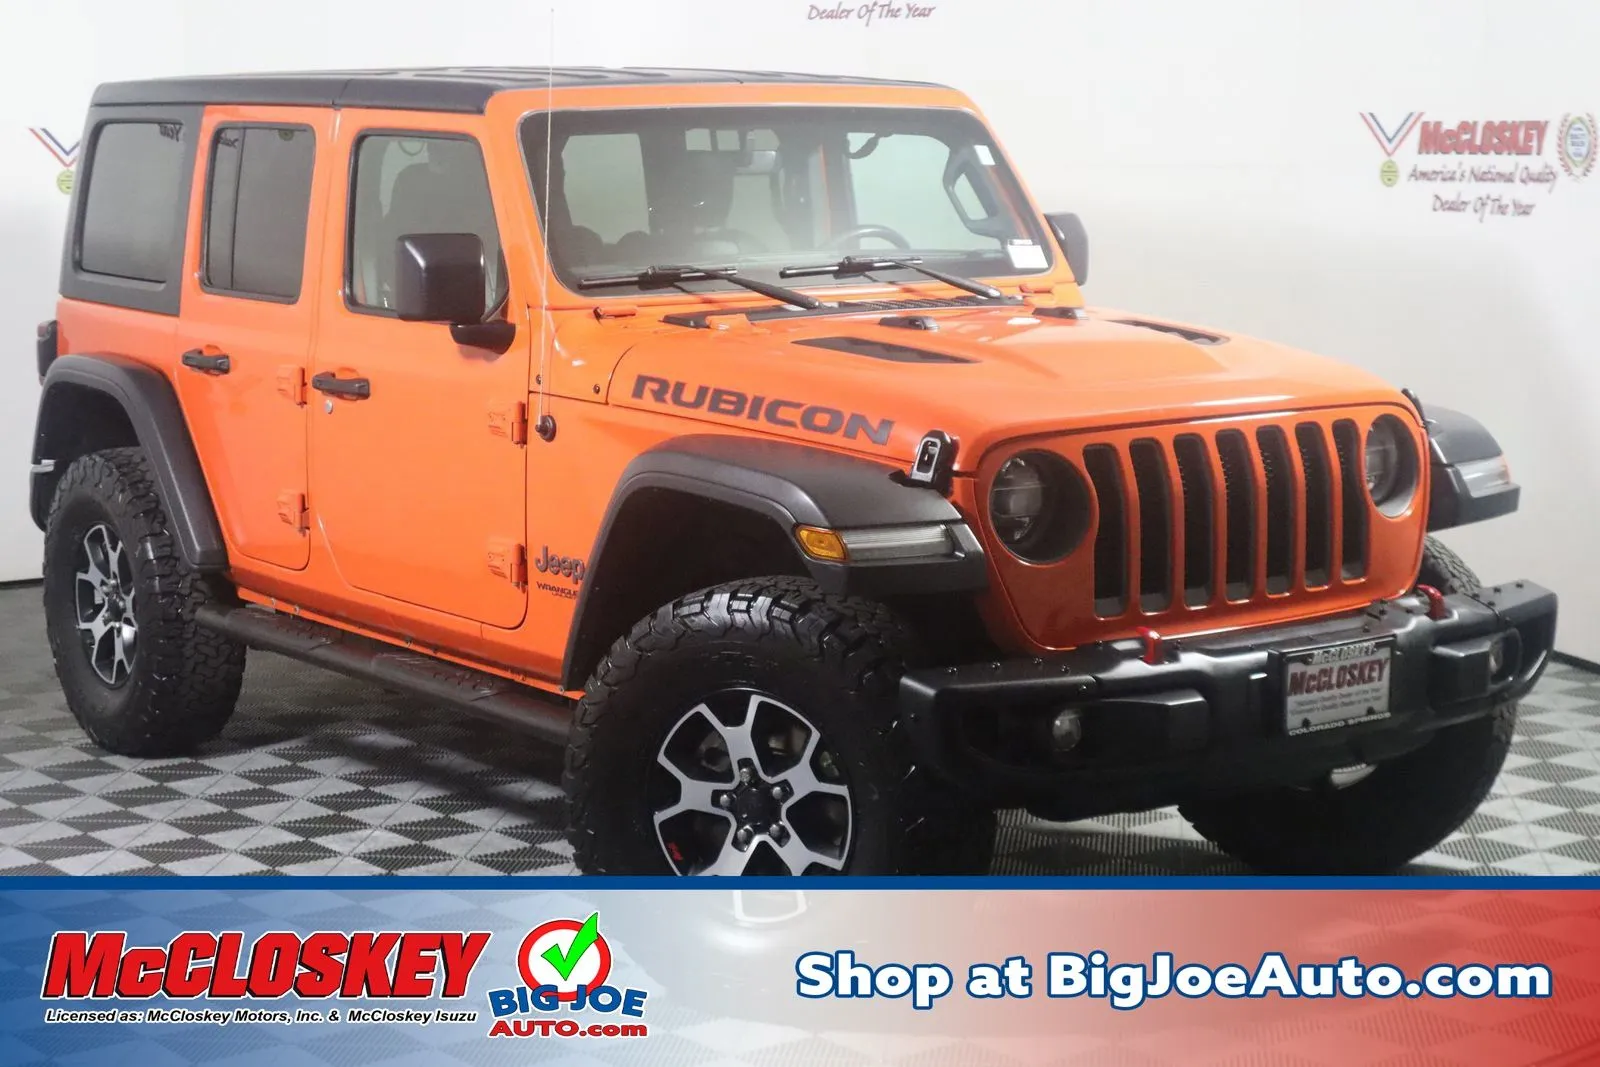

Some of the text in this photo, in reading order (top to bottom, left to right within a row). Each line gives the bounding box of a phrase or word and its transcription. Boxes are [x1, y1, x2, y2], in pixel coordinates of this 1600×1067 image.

[807, 0, 936, 27] Dealer Of The Year
[1417, 120, 1549, 155] McCLOSKEY
[1407, 161, 1466, 183] America's
[1469, 162, 1516, 184] National
[1519, 162, 1557, 194] Quality
[1431, 192, 1536, 223] Dealer Of The Year
[631, 374, 895, 446] RUBICON
[535, 544, 585, 585] Jeep
[1289, 659, 1388, 695] McCLOSKEY
[1289, 712, 1392, 736] COLORADO SPRINGS
